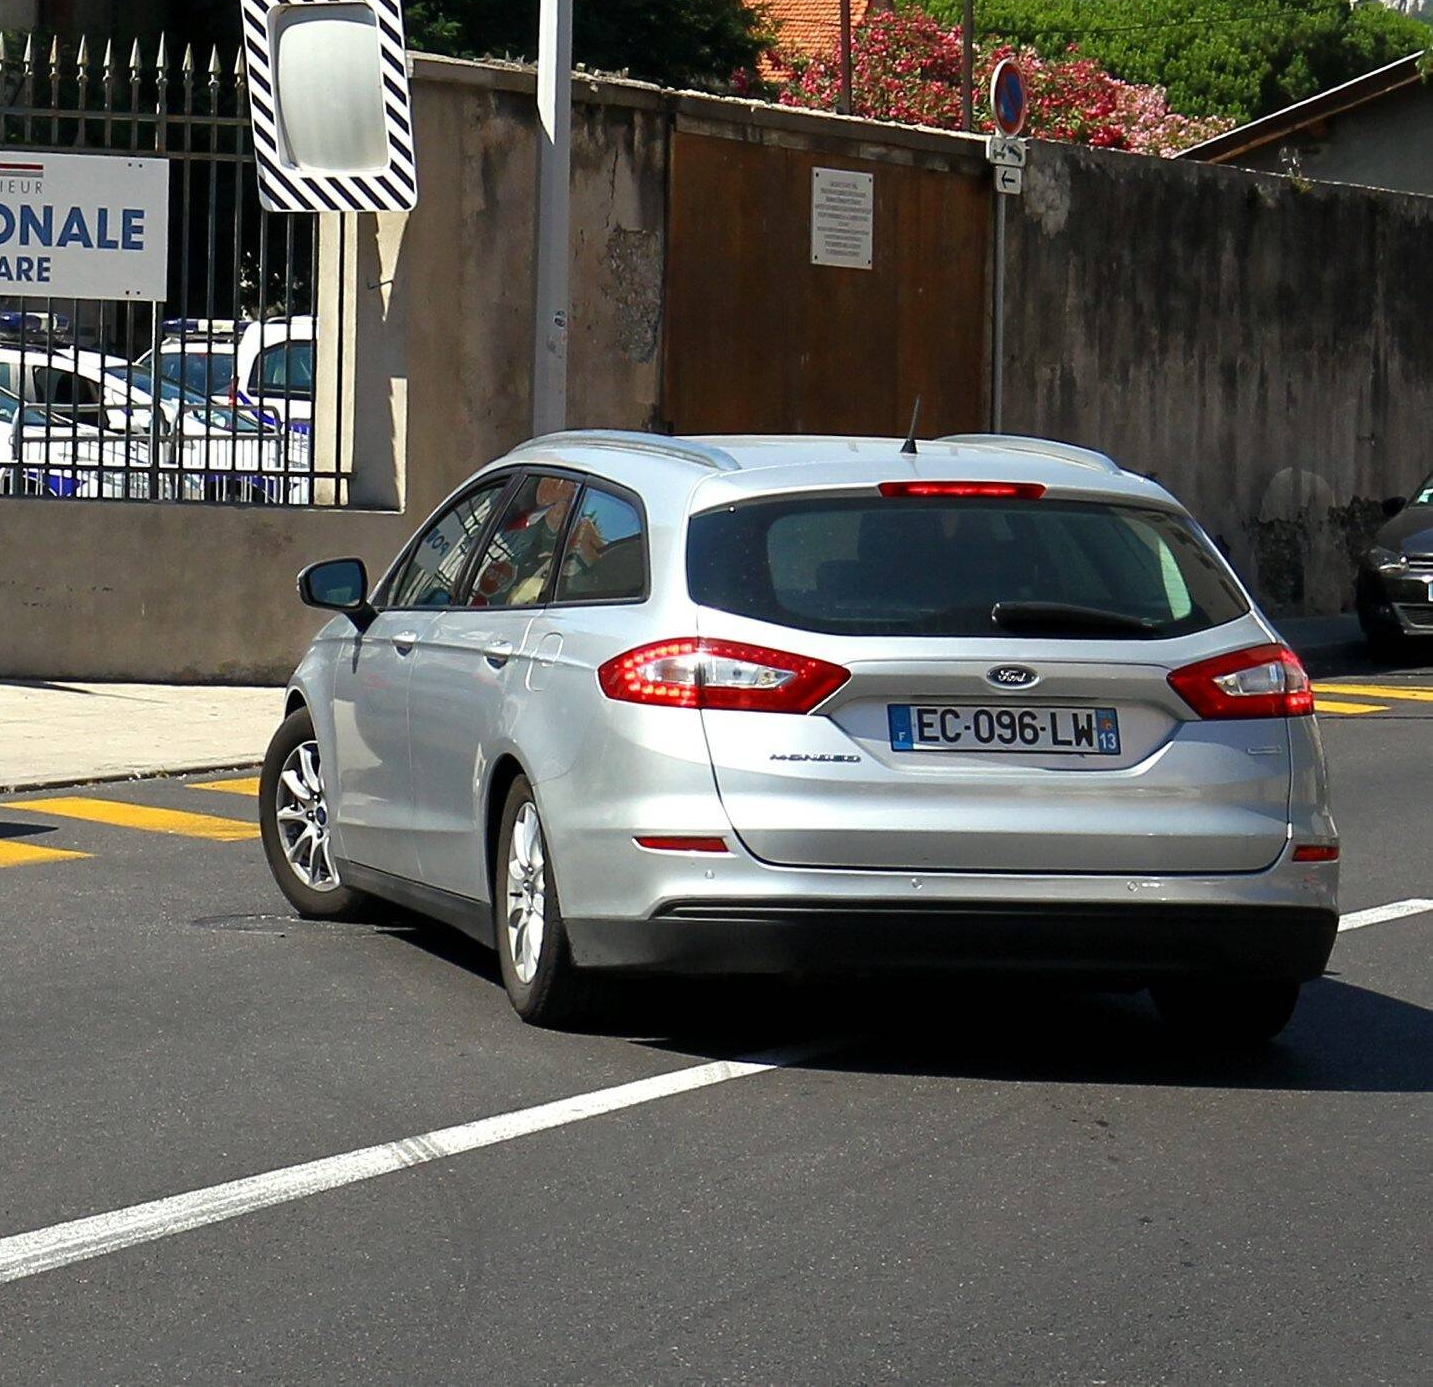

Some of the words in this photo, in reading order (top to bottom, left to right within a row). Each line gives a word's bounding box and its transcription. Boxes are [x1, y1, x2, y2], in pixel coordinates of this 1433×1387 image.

[899, 732, 906, 742] F
[917, 708, 1094, 747] EC-096-LW
[1100, 733, 1117, 749] 13
